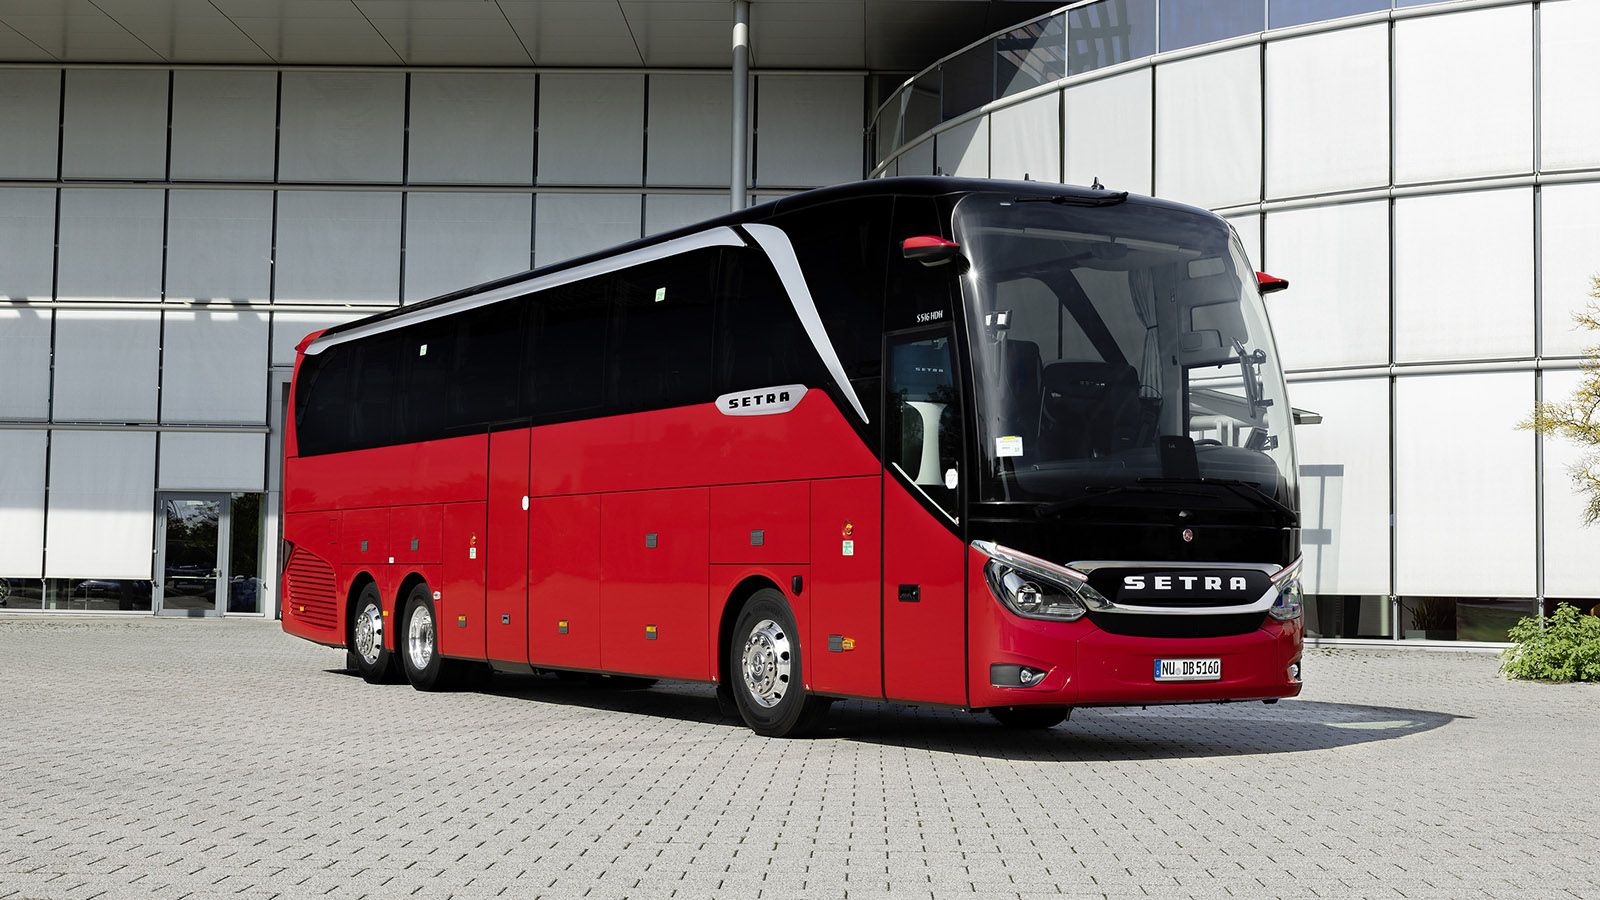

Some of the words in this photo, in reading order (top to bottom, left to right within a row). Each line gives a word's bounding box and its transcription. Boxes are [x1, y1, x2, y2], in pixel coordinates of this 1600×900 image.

[930, 310, 943, 320] HDH
[728, 392, 790, 409] SETRA
[1124, 576, 1247, 590] SETRA
[1162, 661, 1175, 675] NU
